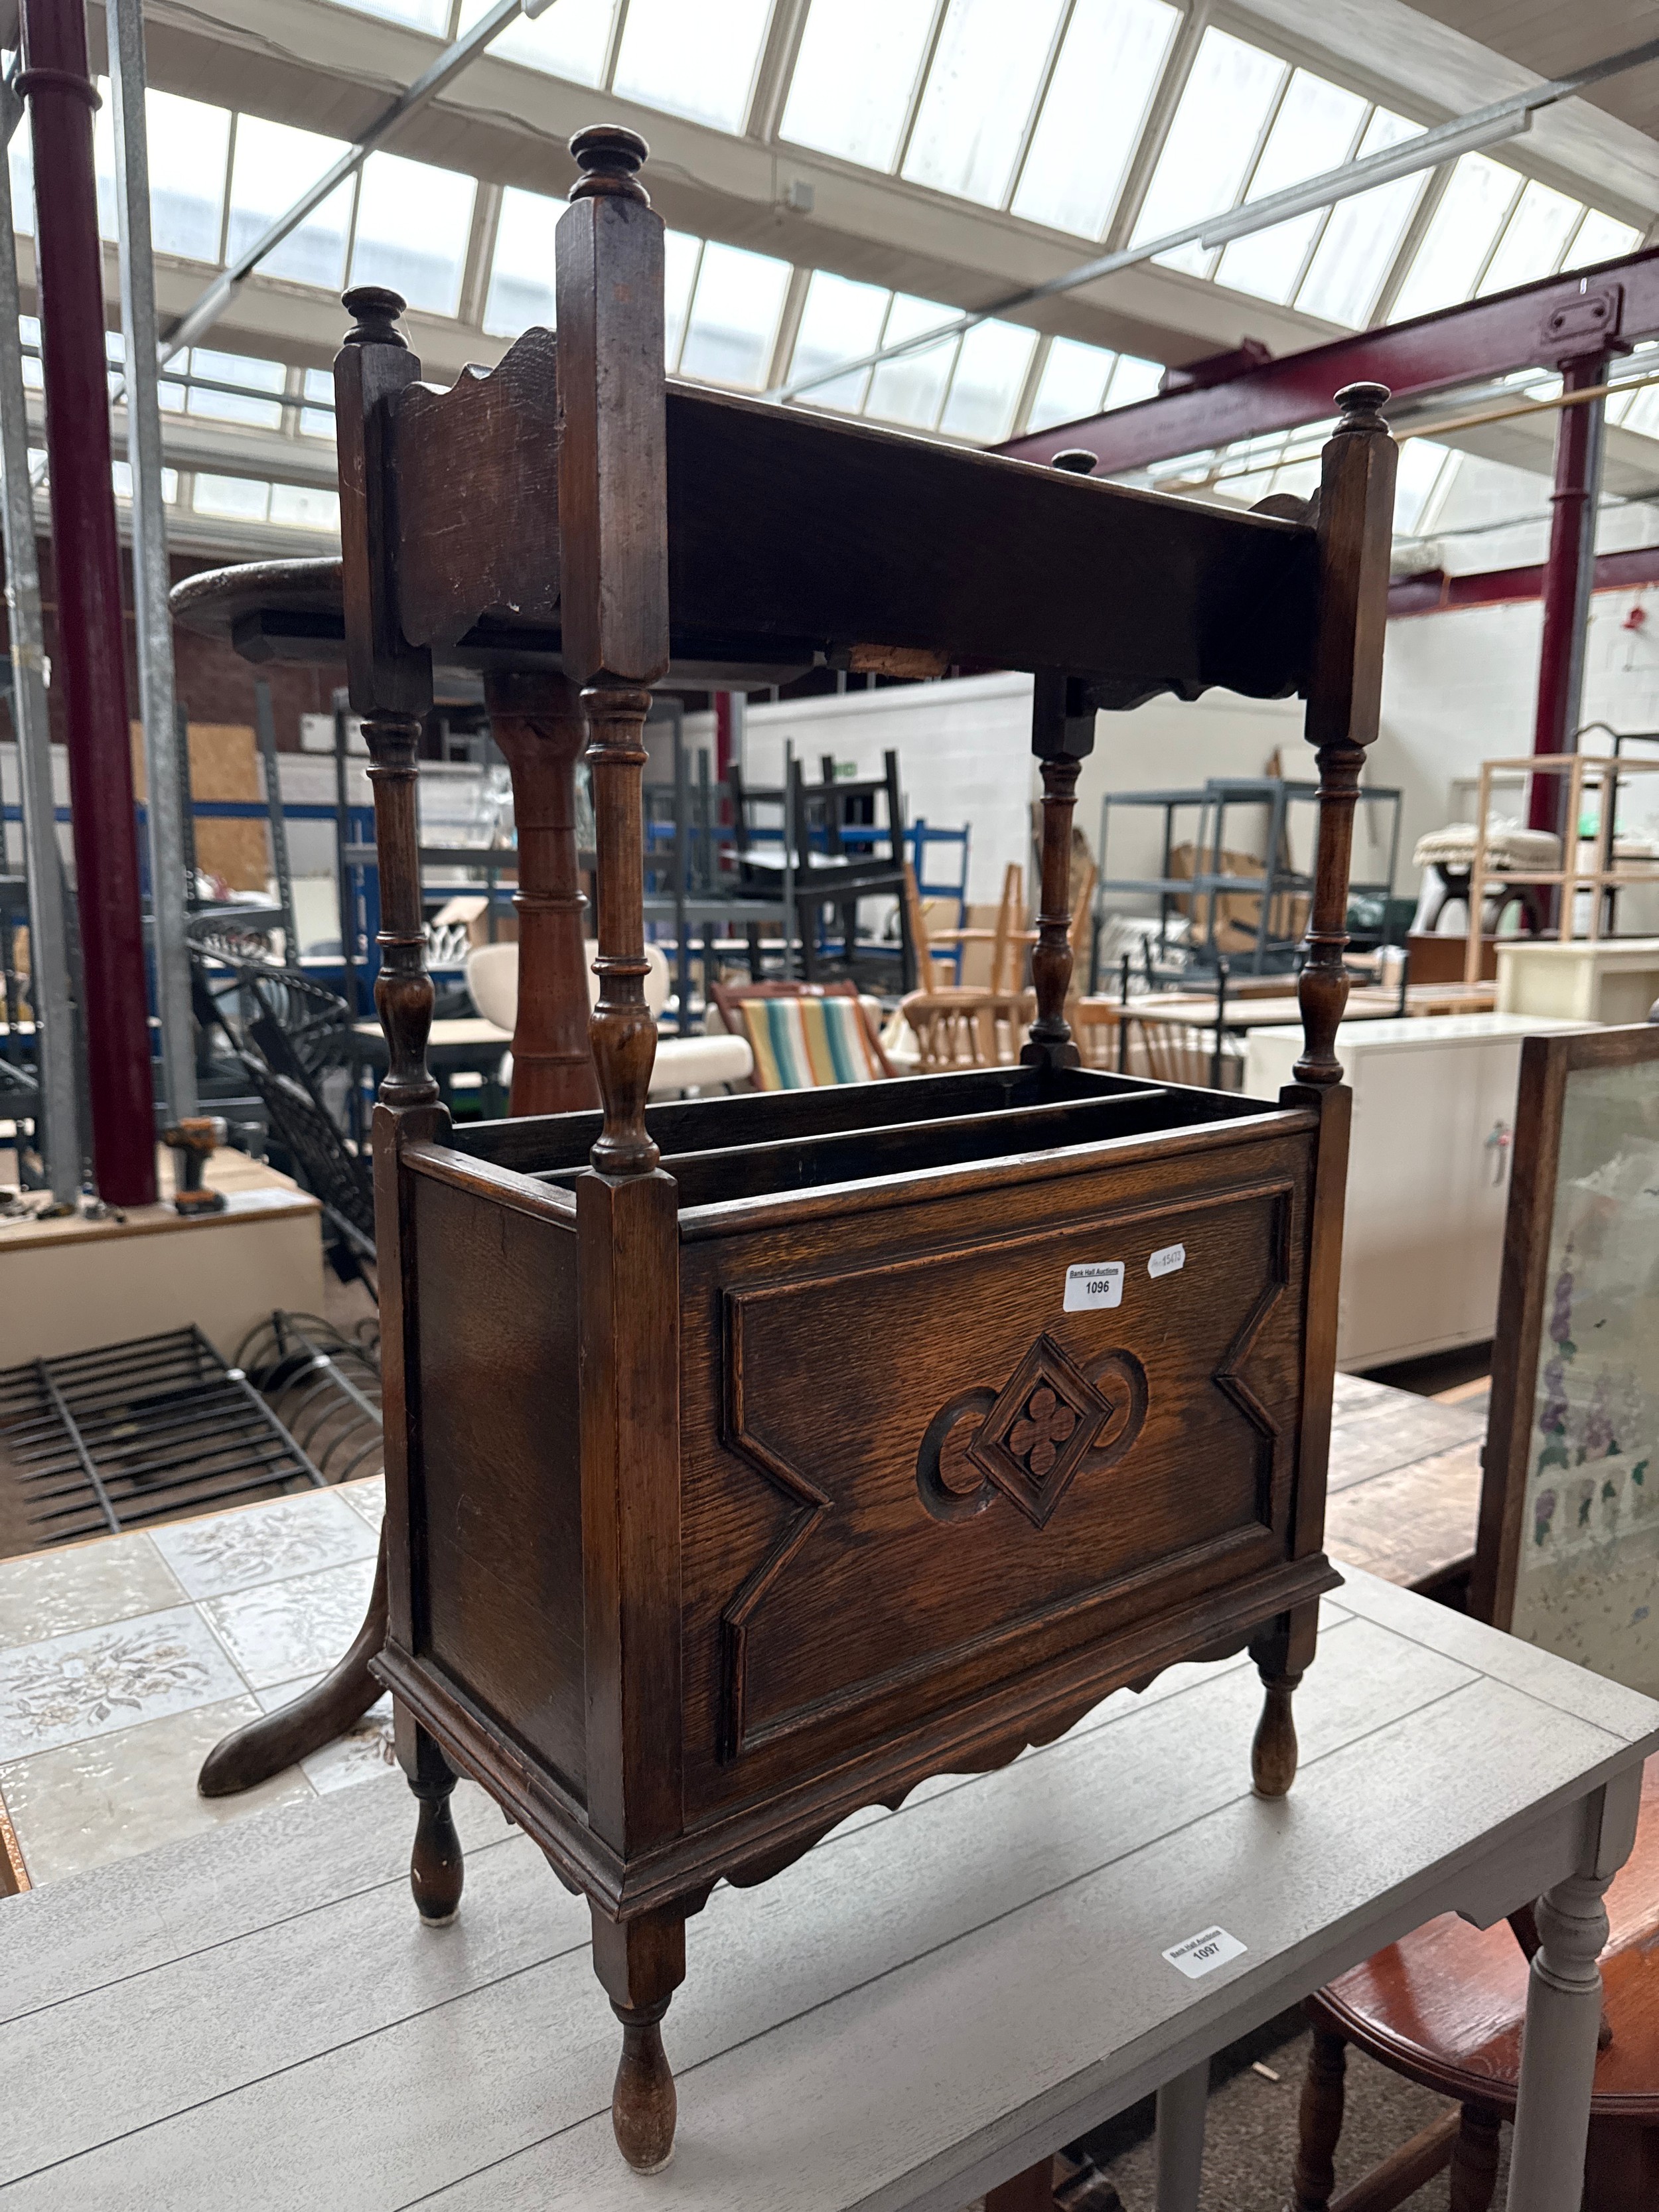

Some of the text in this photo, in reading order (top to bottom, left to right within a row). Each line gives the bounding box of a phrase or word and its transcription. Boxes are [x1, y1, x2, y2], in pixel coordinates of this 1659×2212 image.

[1086, 1280, 1110, 1293] 1096
[1170, 1930, 1222, 1958] Bank Hall Auctions
[1194, 1943, 1220, 1960] 1097
